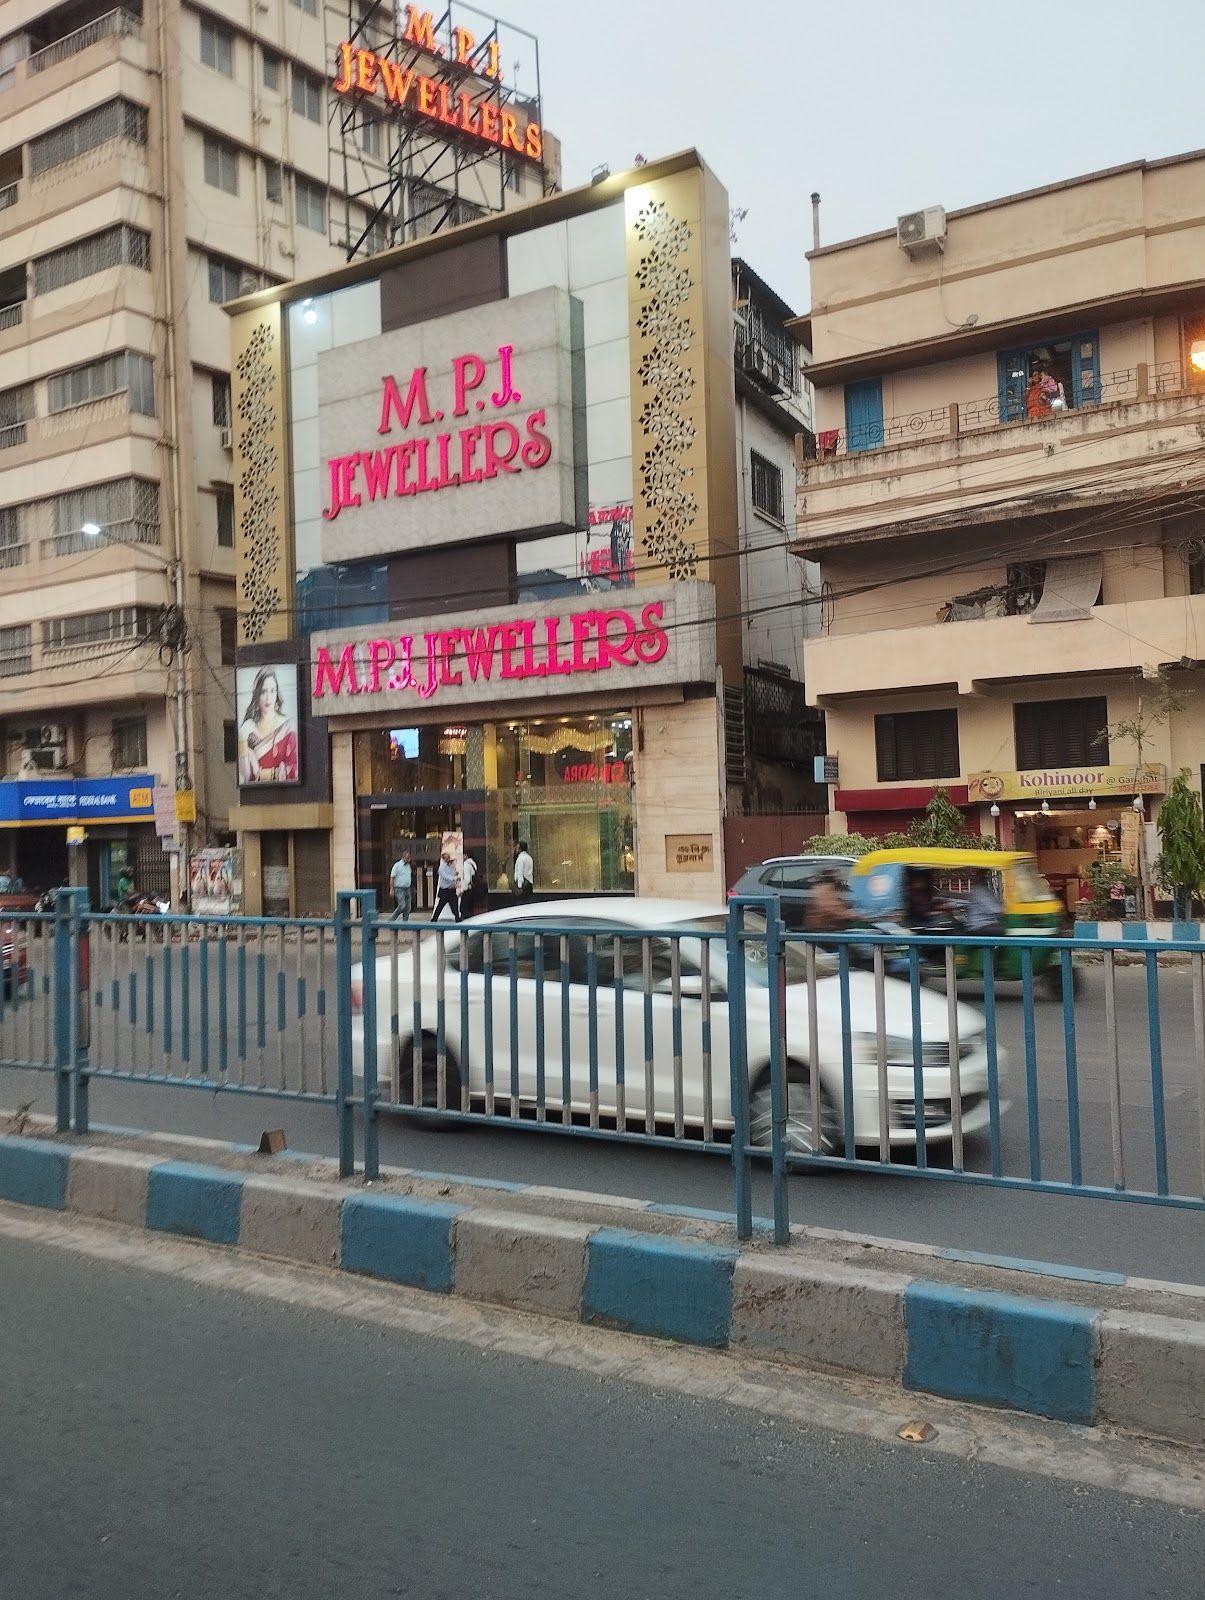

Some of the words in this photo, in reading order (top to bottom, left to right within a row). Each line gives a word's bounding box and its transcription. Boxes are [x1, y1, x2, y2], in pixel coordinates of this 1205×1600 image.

[335, 40, 542, 158] JEWELLERS
[322, 409, 552, 521] JEWELLERS
[418, 601, 669, 698] JEWELLERS
[1020, 771, 1105, 788] Kohinoor
[1106, 777, 1116, 786] @
[1079, 786, 1094, 795] day
